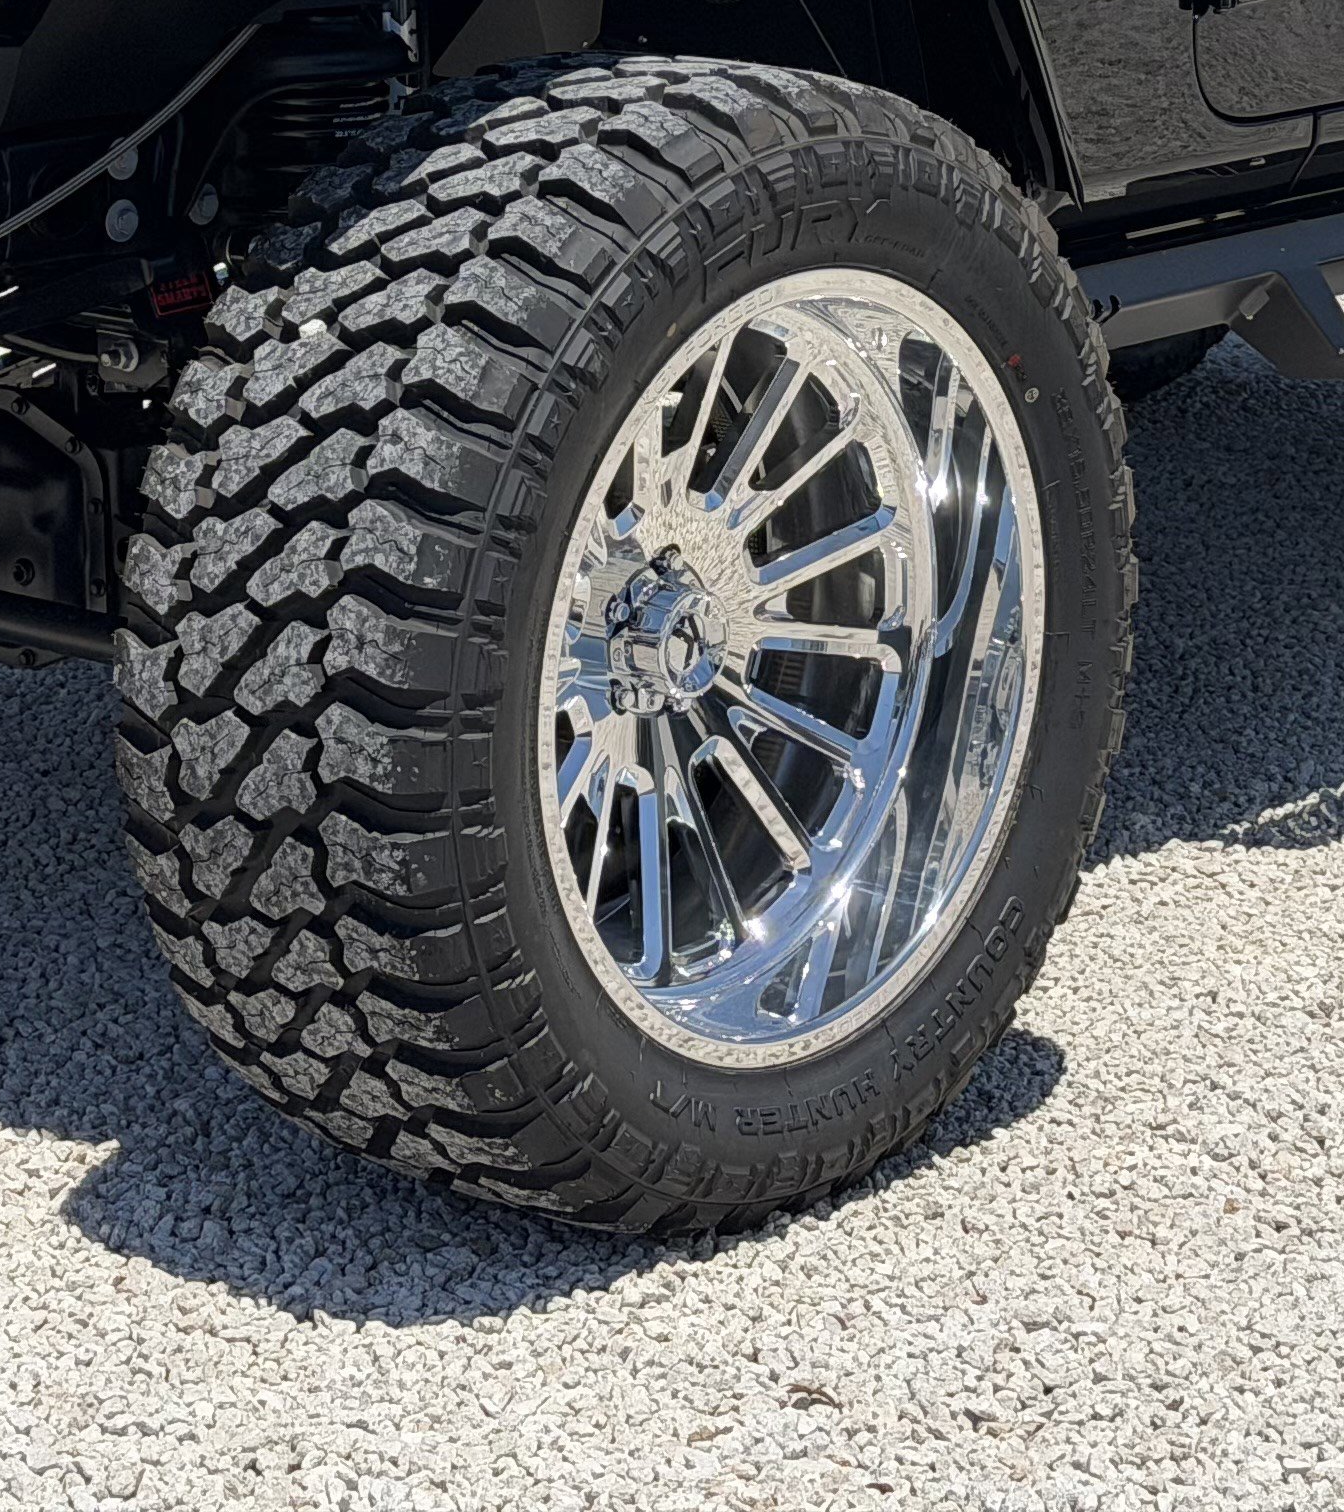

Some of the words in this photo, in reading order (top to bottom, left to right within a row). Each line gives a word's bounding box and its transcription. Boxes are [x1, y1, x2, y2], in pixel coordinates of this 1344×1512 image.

[702, 197, 892, 304] FURY
[888, 894, 1026, 1083] COUNTRY
[732, 1067, 882, 1137] HUNTER
